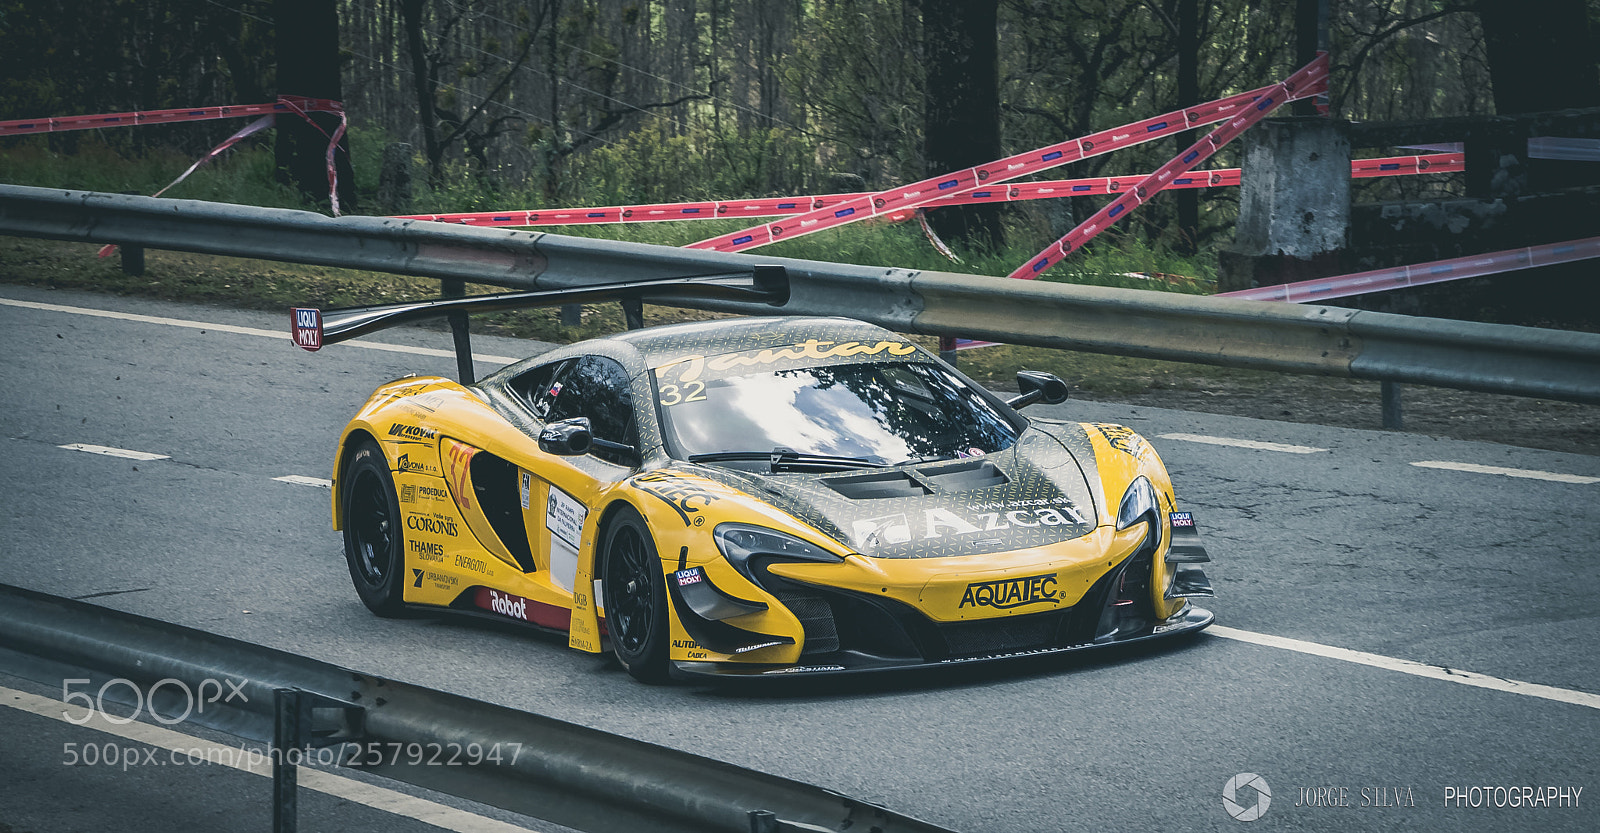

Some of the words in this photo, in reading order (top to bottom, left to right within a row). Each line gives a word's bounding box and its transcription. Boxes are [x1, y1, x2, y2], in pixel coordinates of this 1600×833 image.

[297, 310, 317, 328] LIQUI
[299, 329, 318, 346] MOLY
[659, 381, 707, 406] 32
[418, 486, 448, 499] PROEDUCA
[407, 515, 459, 538] CORONIS
[923, 505, 1089, 540] Azcar
[409, 540, 444, 556] THAMES
[677, 569, 699, 579] LIQUI
[680, 576, 702, 586] MOLY
[574, 592, 588, 606] DGB
[958, 573, 1060, 609] AQUATEC
